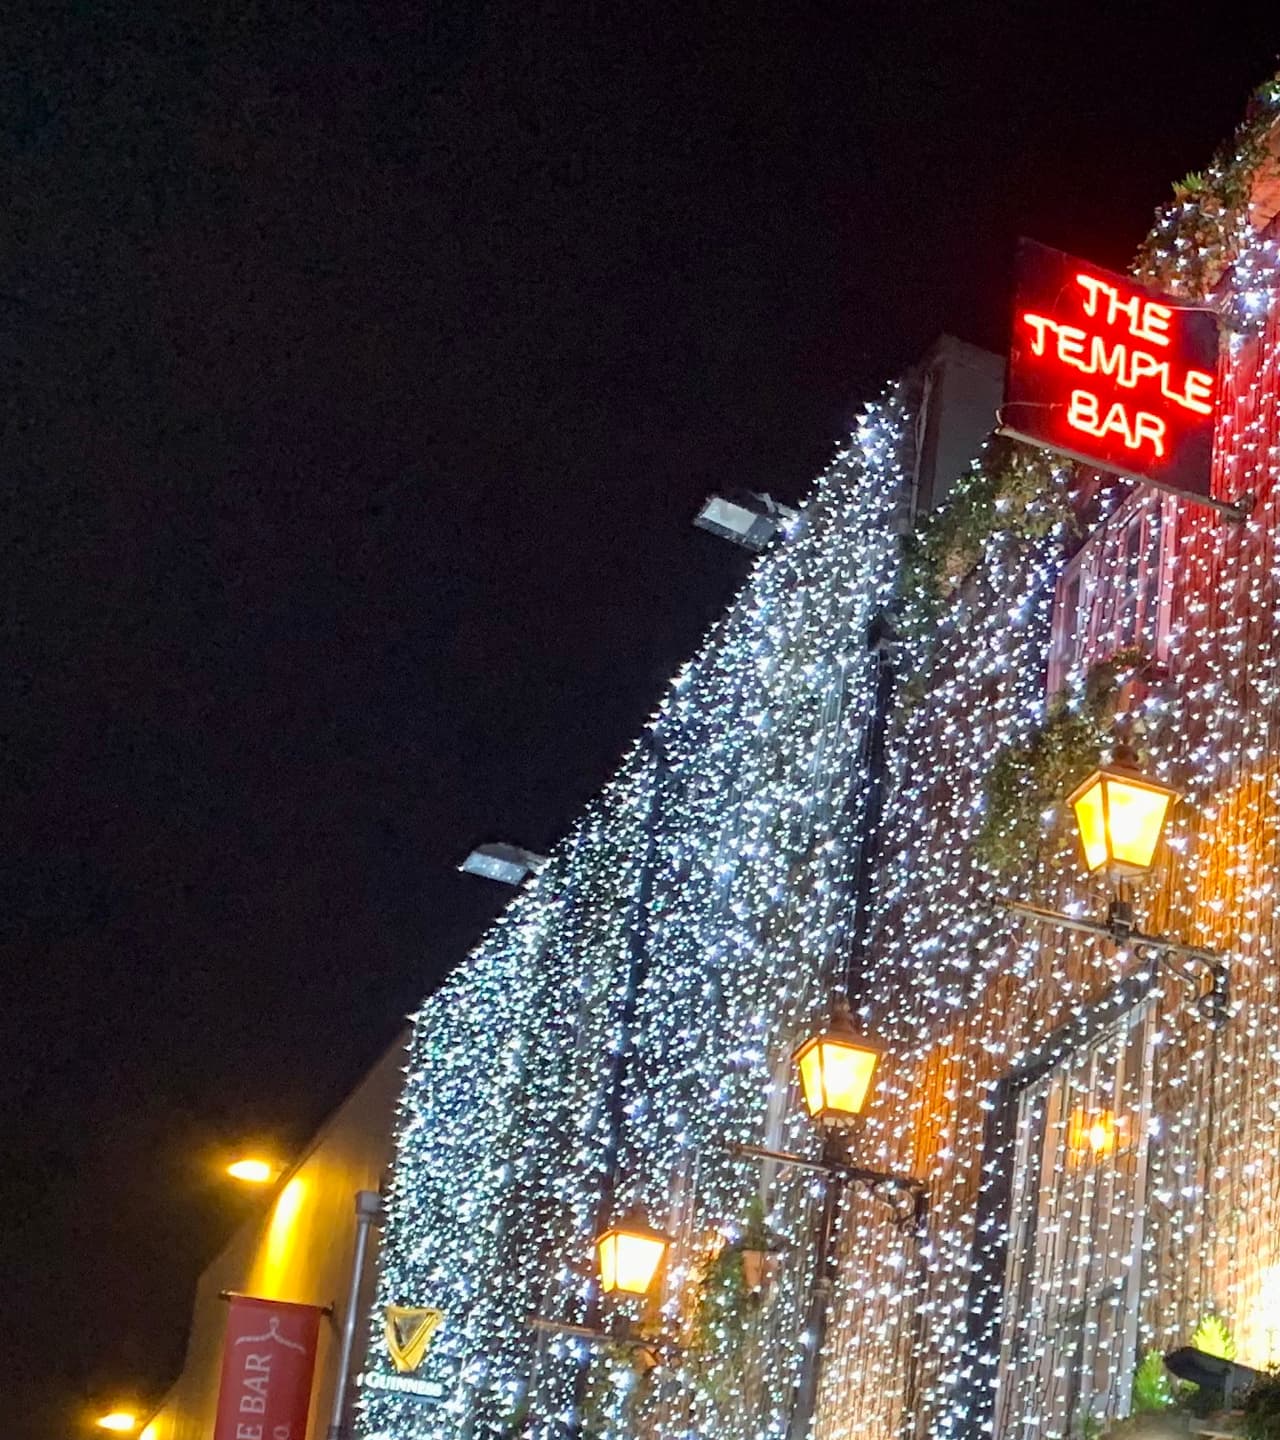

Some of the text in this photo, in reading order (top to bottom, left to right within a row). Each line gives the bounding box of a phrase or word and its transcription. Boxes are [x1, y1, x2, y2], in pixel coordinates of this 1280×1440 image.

[1076, 274, 1172, 346] THE
[1023, 313, 1214, 414] TEMPLE
[1067, 390, 1166, 457] BAR
[239, 1352, 273, 1415] BAR
